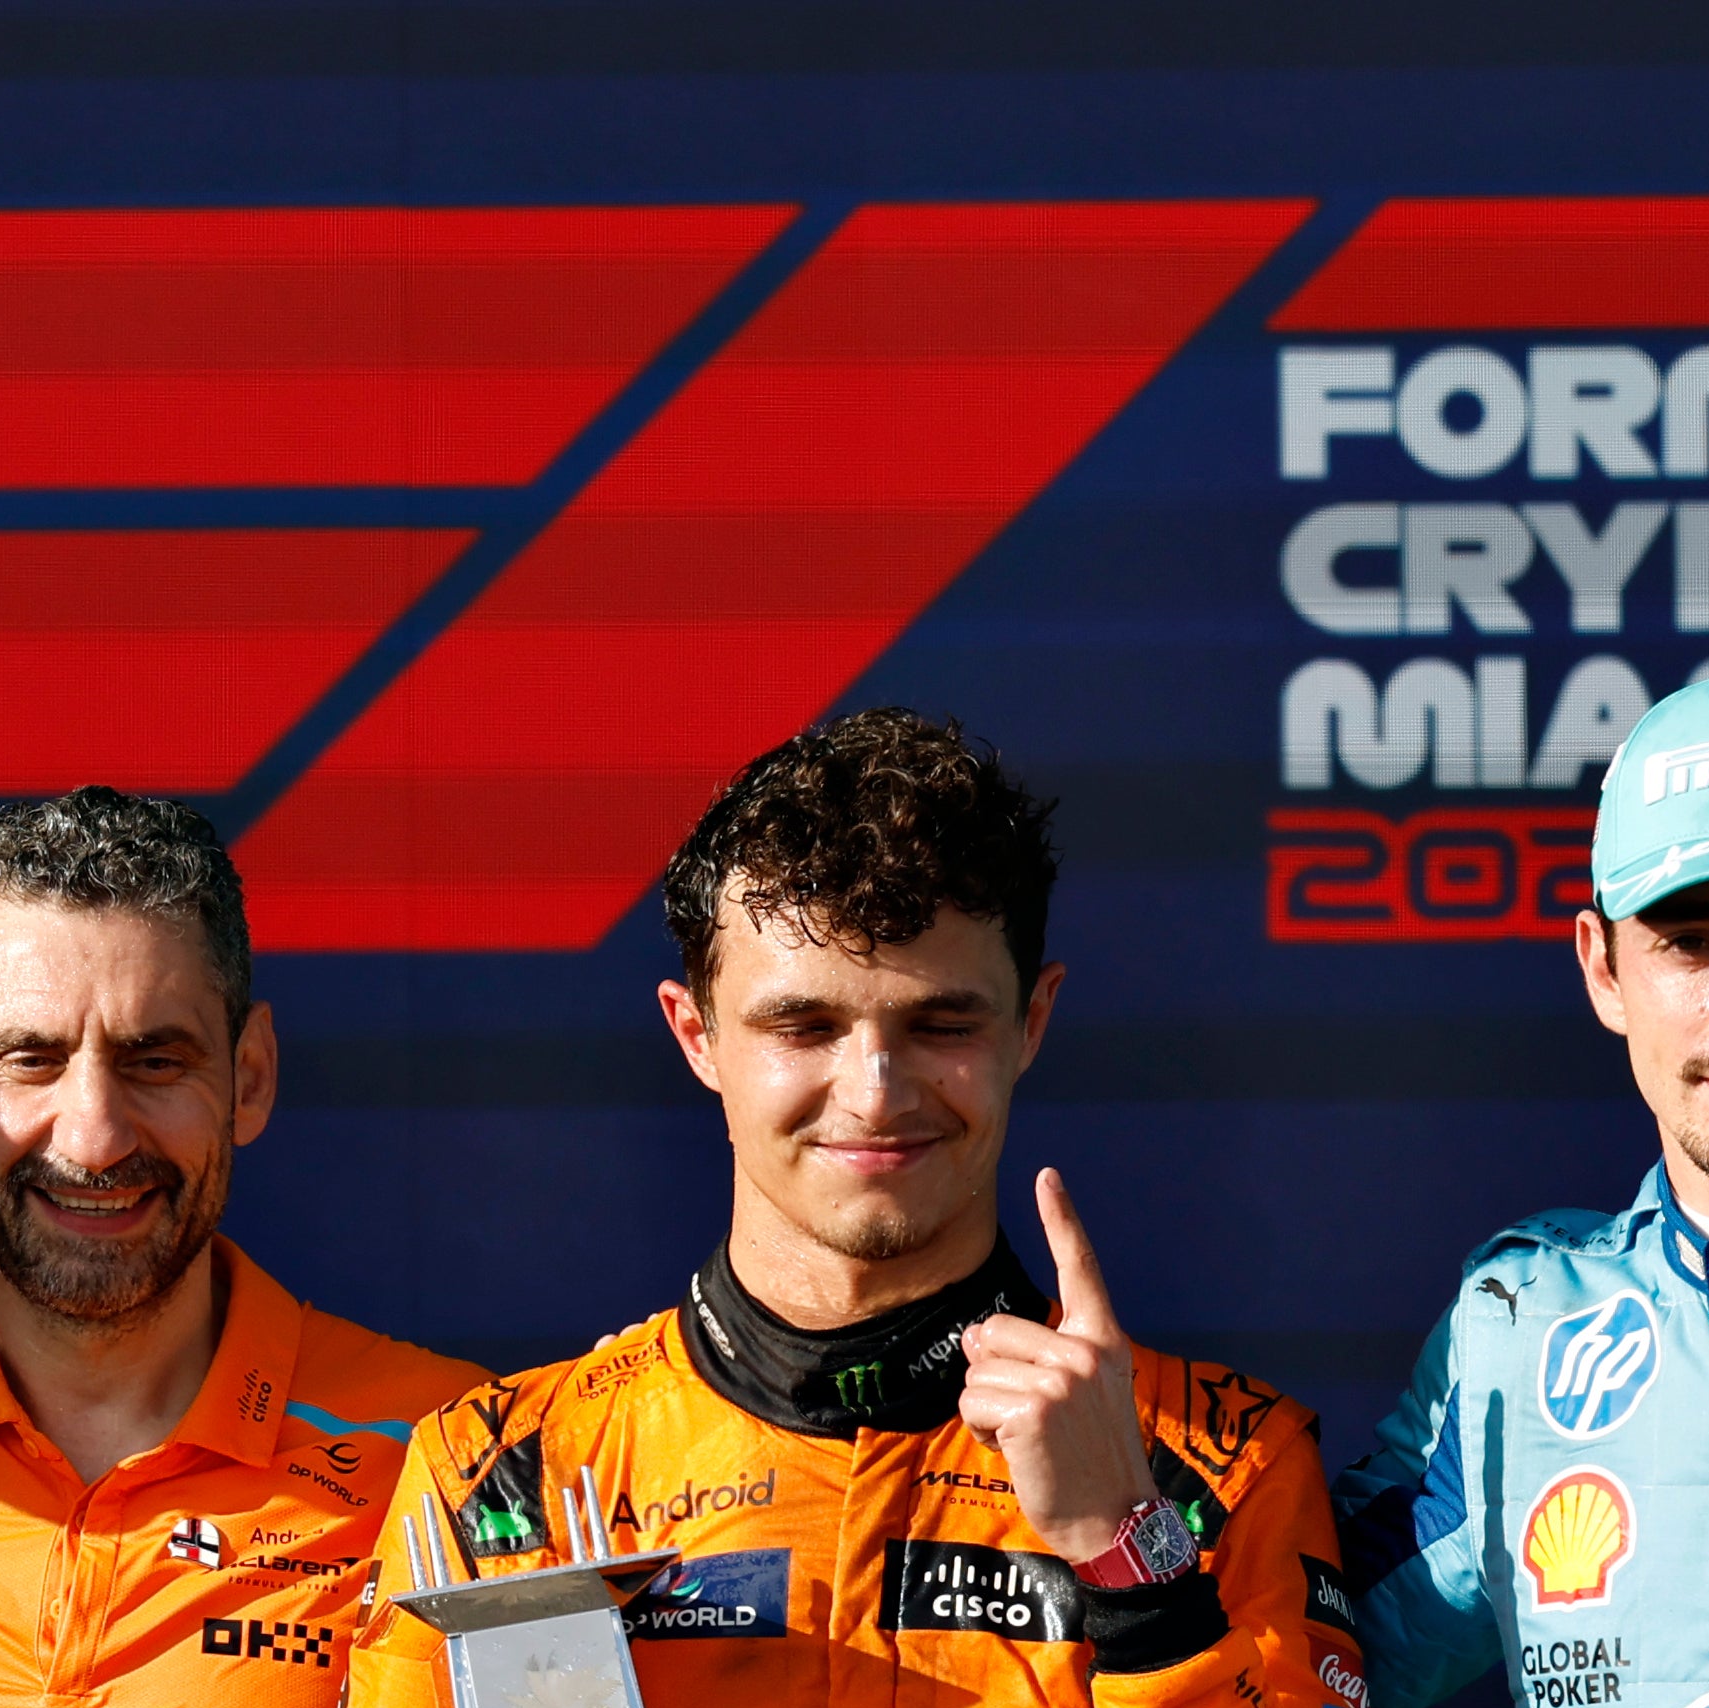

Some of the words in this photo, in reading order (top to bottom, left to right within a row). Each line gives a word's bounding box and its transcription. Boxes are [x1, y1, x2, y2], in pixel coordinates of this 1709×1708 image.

[287, 1463, 313, 1481] DP
[313, 1473, 369, 1508] WORLD
[909, 1470, 1016, 1495] McLa
[609, 1468, 776, 1533] Android
[942, 1496, 1006, 1511] FORMULA
[228, 1576, 285, 1590] FORMULA
[652, 1606, 756, 1630] WORLD
[202, 1617, 333, 1668] OKX
[1522, 1636, 1631, 1671] GLOBAL
[1533, 1671, 1622, 1708] POKER
